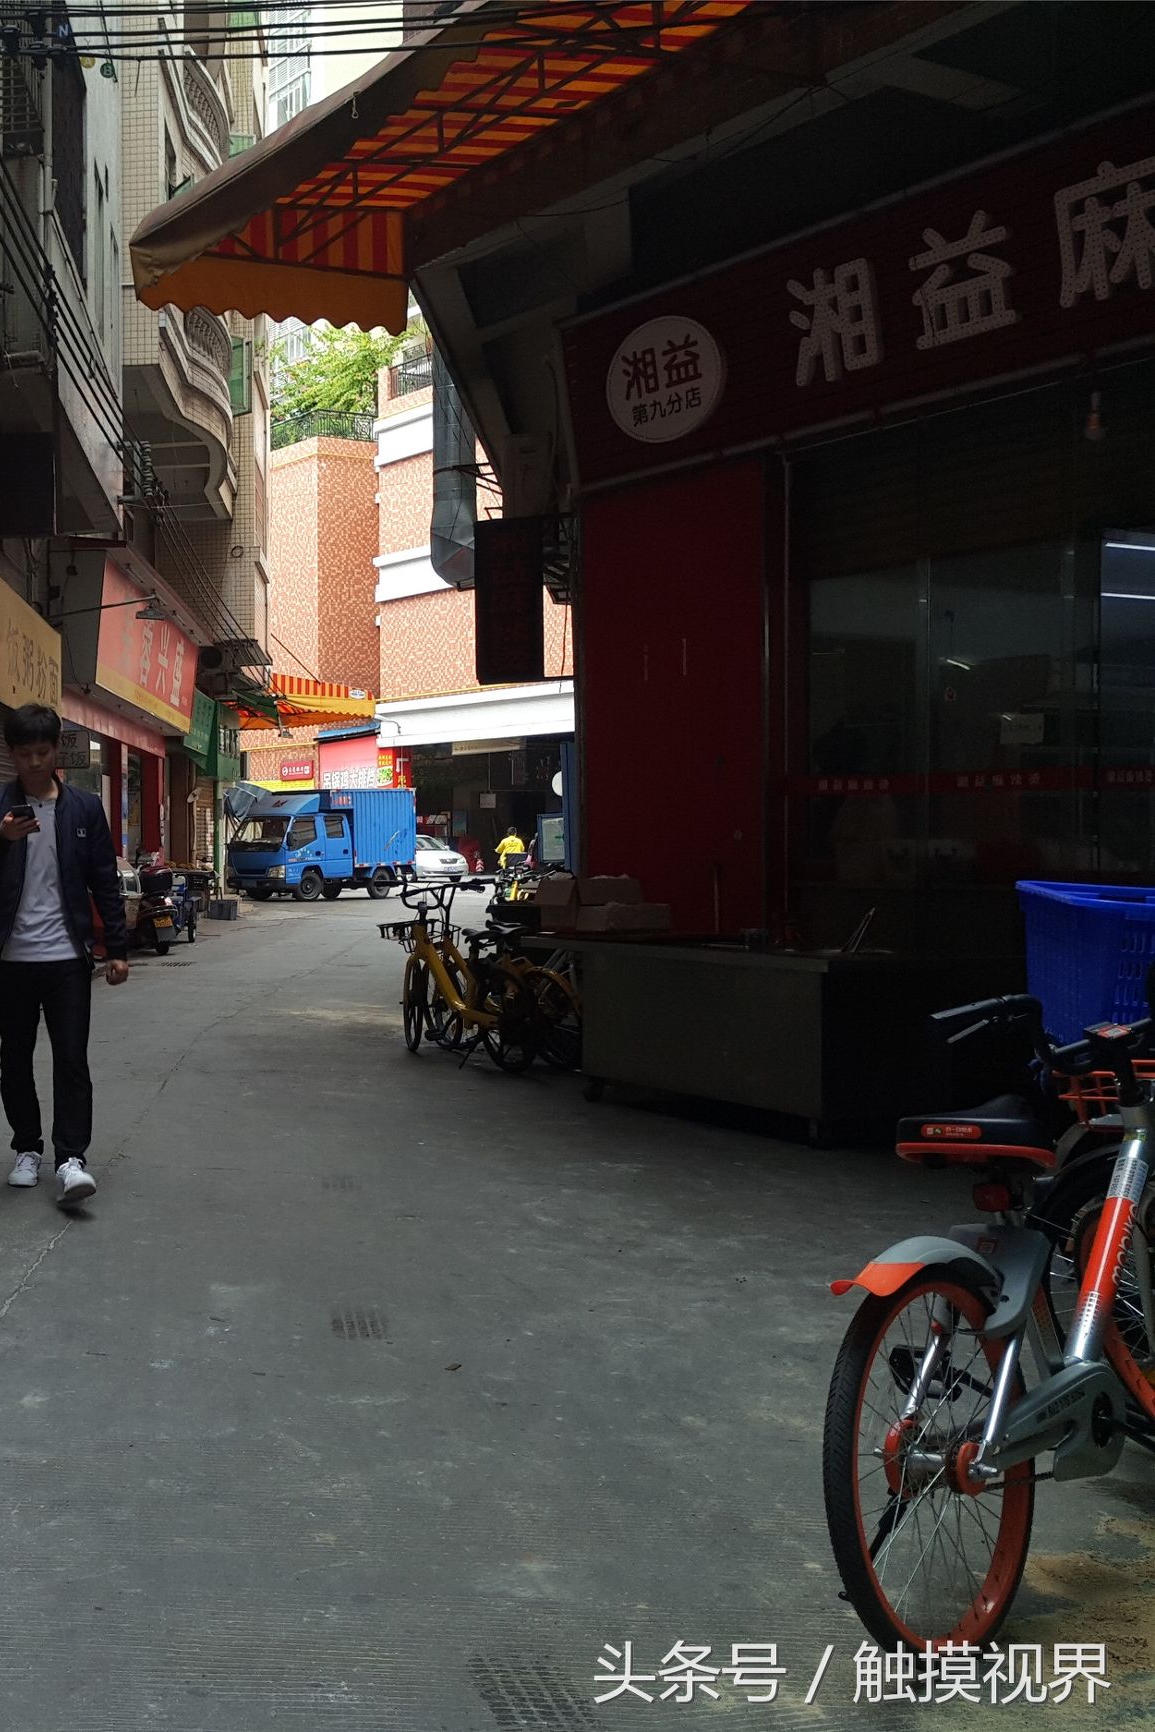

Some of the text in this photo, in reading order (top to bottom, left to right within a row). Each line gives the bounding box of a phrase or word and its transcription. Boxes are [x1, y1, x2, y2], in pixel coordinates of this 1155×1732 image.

[786, 156, 1155, 387] 湘益麻
[621, 333, 703, 401] 湘益
[631, 386, 702, 427] 第九分店
